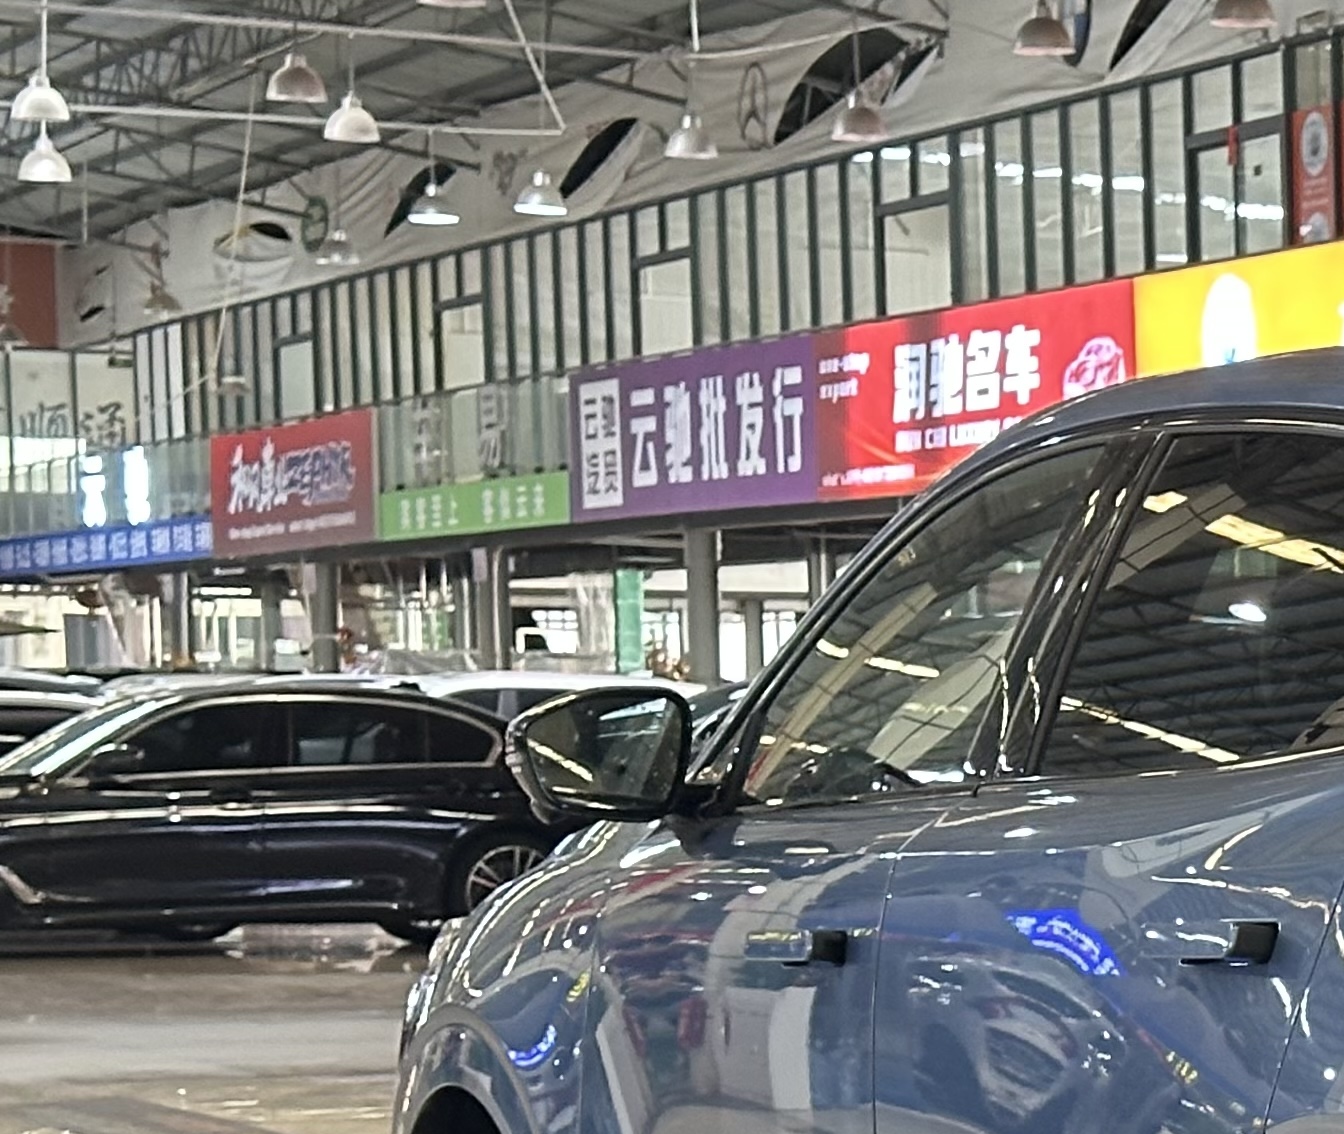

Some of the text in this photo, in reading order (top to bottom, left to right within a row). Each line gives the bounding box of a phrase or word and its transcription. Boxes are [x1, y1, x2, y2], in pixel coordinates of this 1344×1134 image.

[629, 365, 804, 488] 云驰批发行
